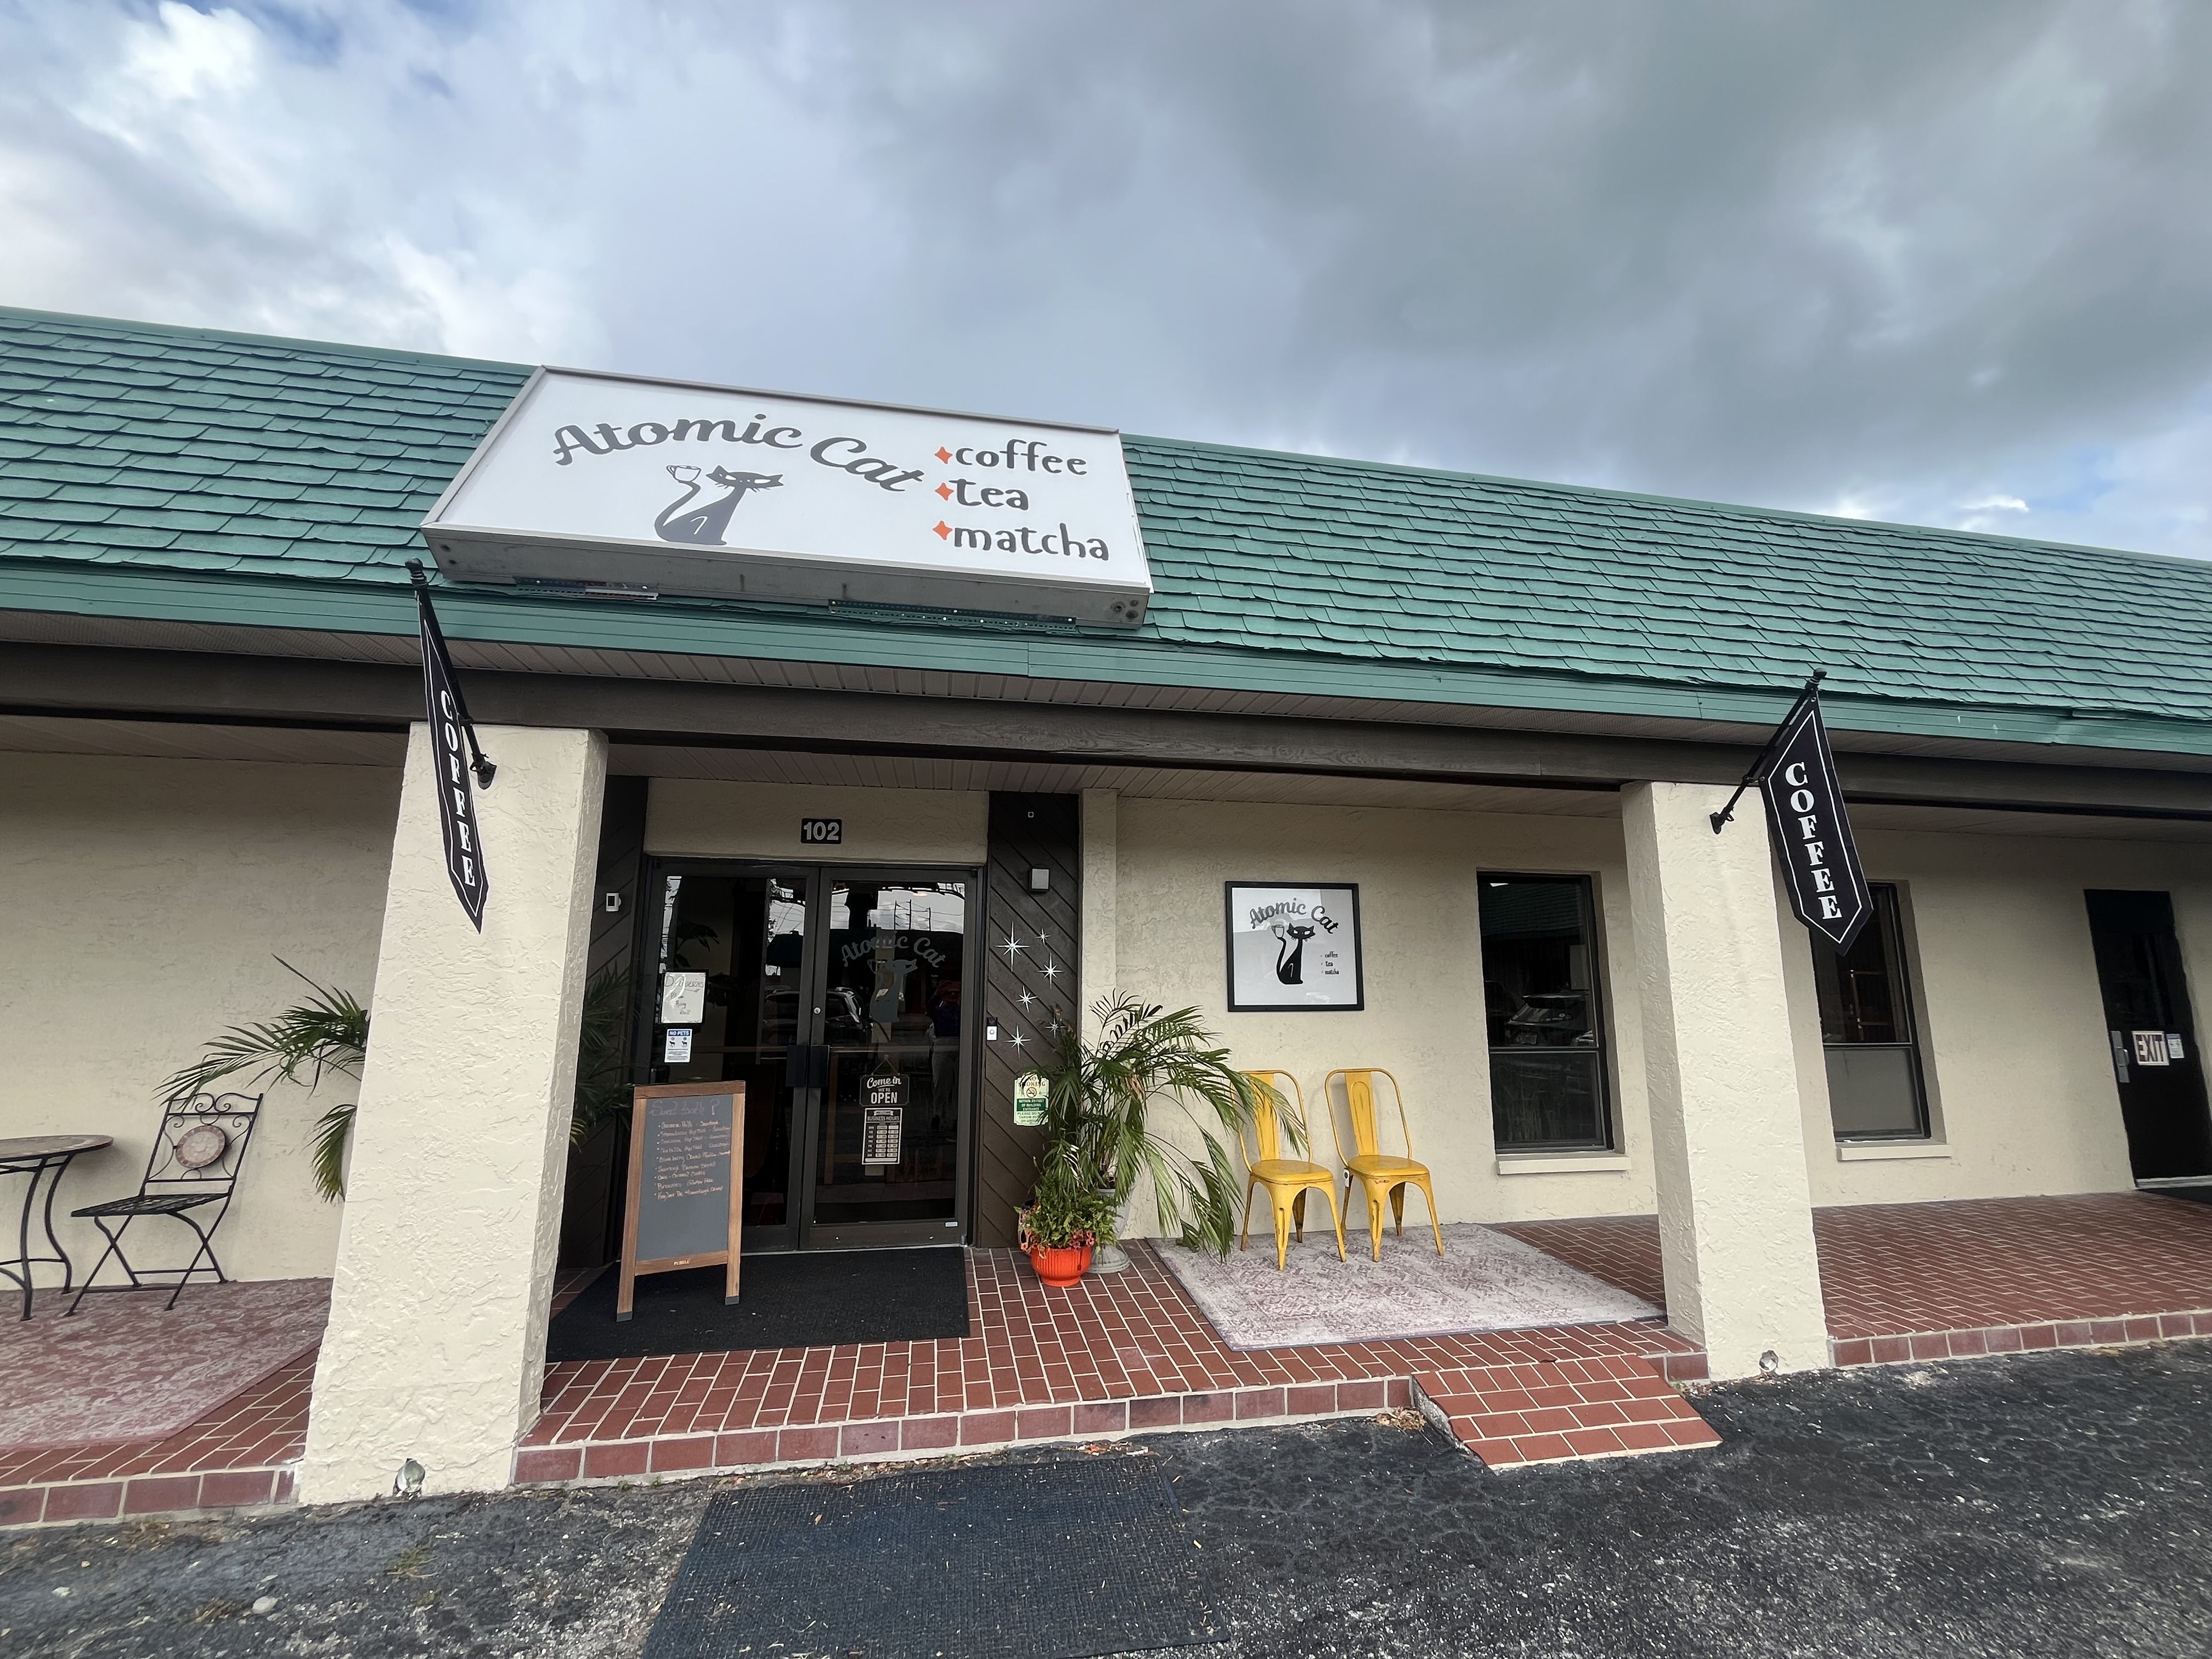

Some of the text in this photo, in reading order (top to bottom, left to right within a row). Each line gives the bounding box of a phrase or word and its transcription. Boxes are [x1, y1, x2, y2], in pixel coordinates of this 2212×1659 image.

[554, 413, 924, 492] Atomic Cat
[956, 438, 1087, 475] coffee
[949, 478, 1029, 510] tea
[955, 522, 1109, 561] matcha
[441, 690, 476, 887] COFFEE
[804, 822, 839, 840] 102
[1785, 761, 1842, 919] COFFEE
[1250, 898, 1339, 934] Atomic Cat
[913, 937, 946, 968] Cat
[2135, 1034, 2164, 1062] EXIT
[867, 1076, 902, 1088] Come in
[871, 1092, 898, 1104] OPEN
